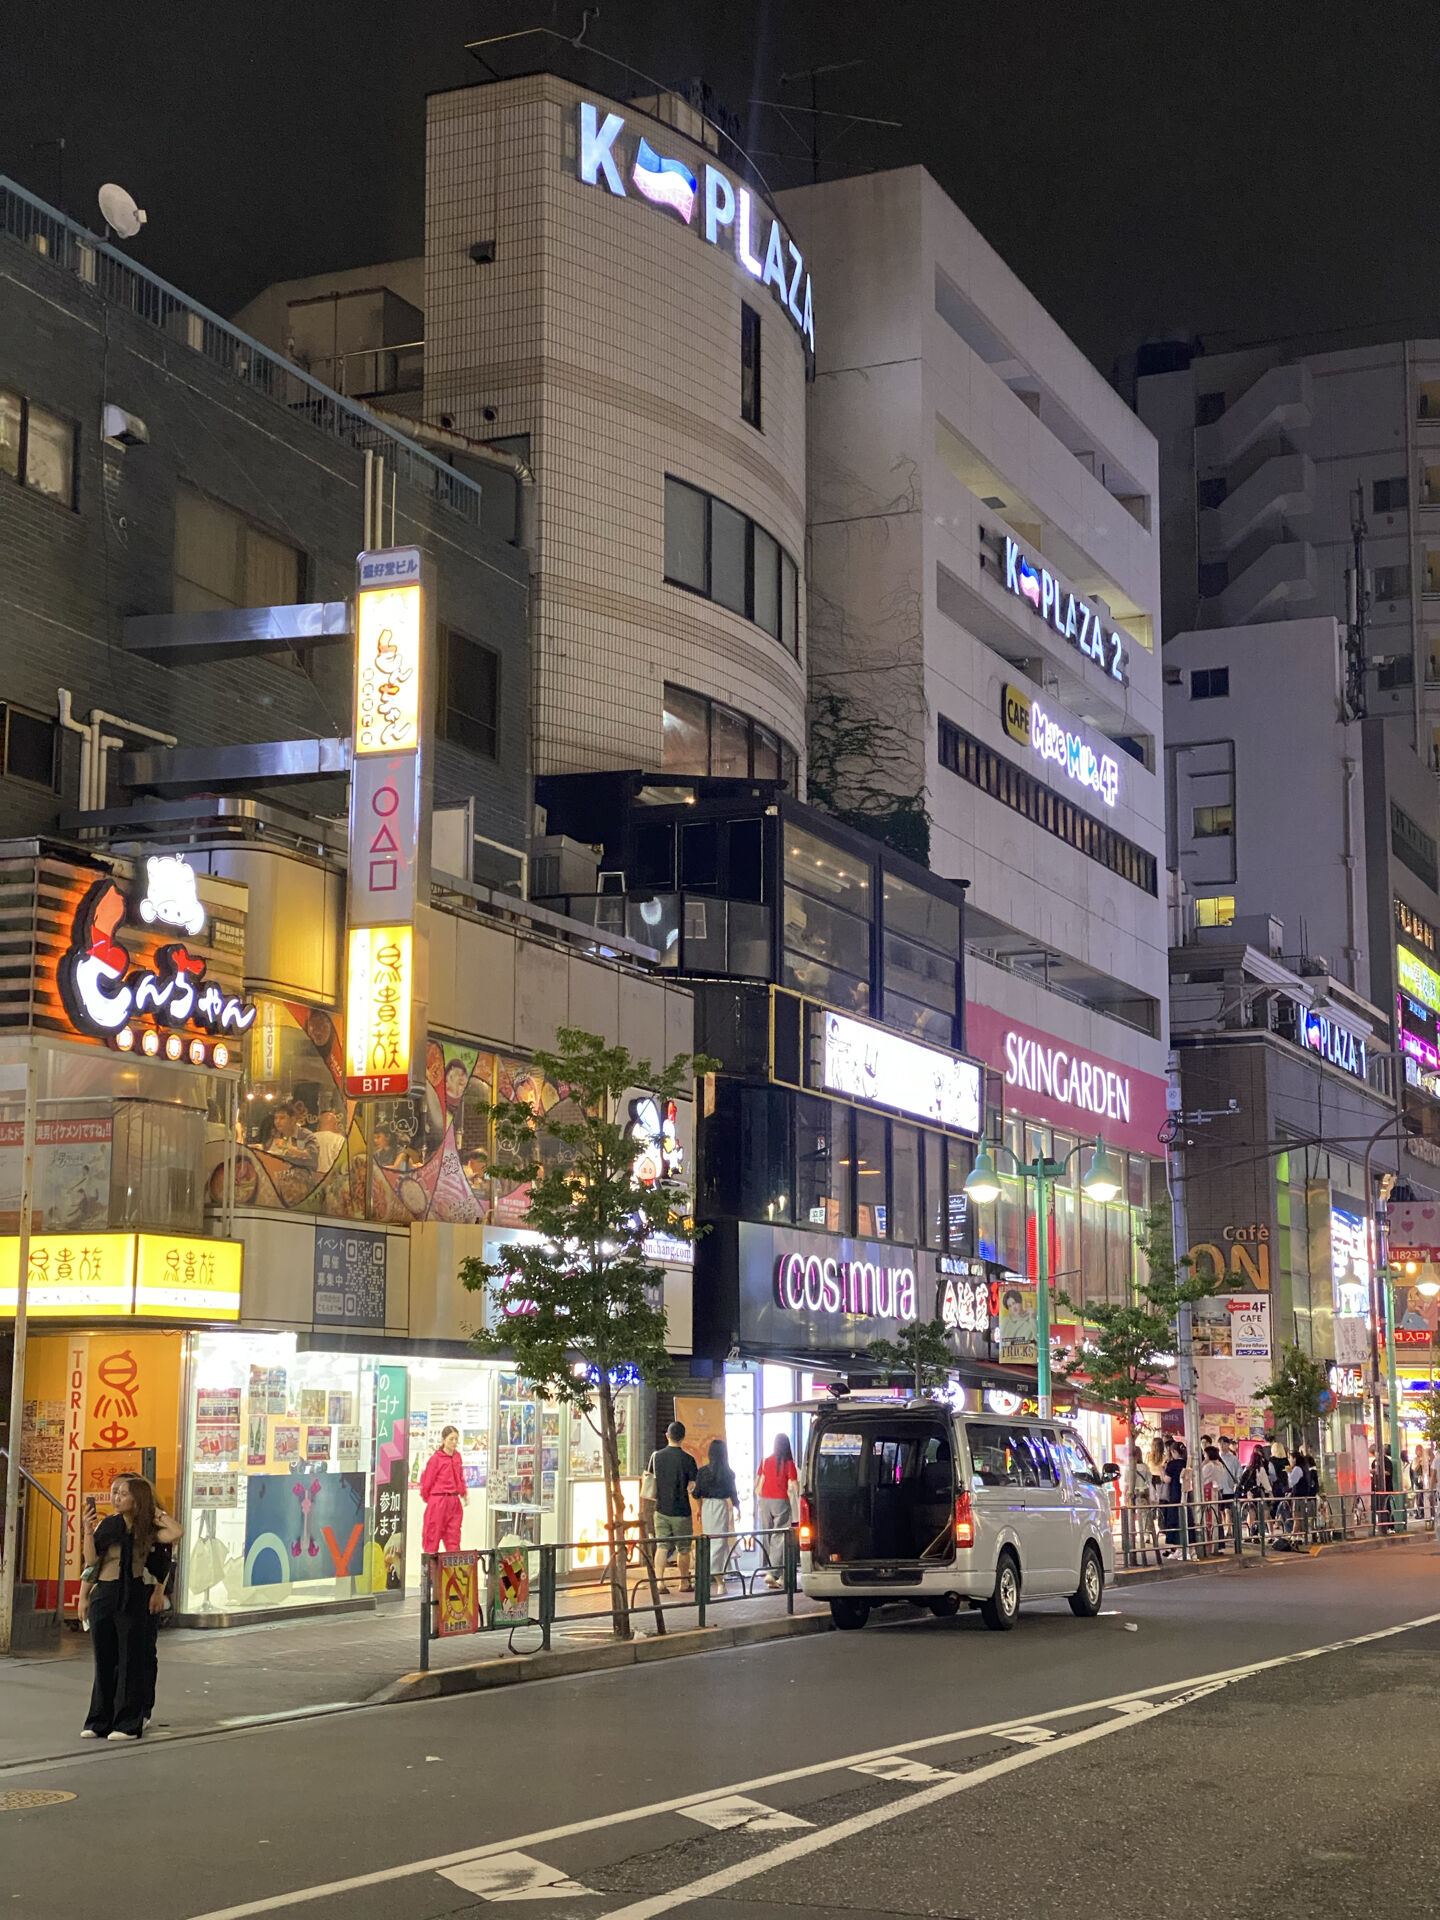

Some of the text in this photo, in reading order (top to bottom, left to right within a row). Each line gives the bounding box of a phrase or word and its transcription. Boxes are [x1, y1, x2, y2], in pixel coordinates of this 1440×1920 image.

[580, 101, 815, 353] K PLAZA
[1005, 536, 1123, 681] K PLAZA 2
[1008, 698, 1030, 734] CAFE
[74, 885, 257, 1028] とんちゃん
[1300, 1004, 1309, 1048] K
[1320, 1022, 1357, 1072] PLAZA
[1359, 1040, 1367, 1079] 1
[362, 1078, 391, 1092] B1F
[1005, 1032, 1131, 1124] SKINGARDEN
[316, 1237, 345, 1252] イベント
[1222, 1221, 1271, 1243] Café
[1189, 1243, 1270, 1290] ON
[1240, 1314, 1262, 1323] CAFE
[1251, 1301, 1267, 1313] 4F
[65, 1350, 85, 1555] TORIKIZOKU
[379, 1492, 401, 1513] 参加
